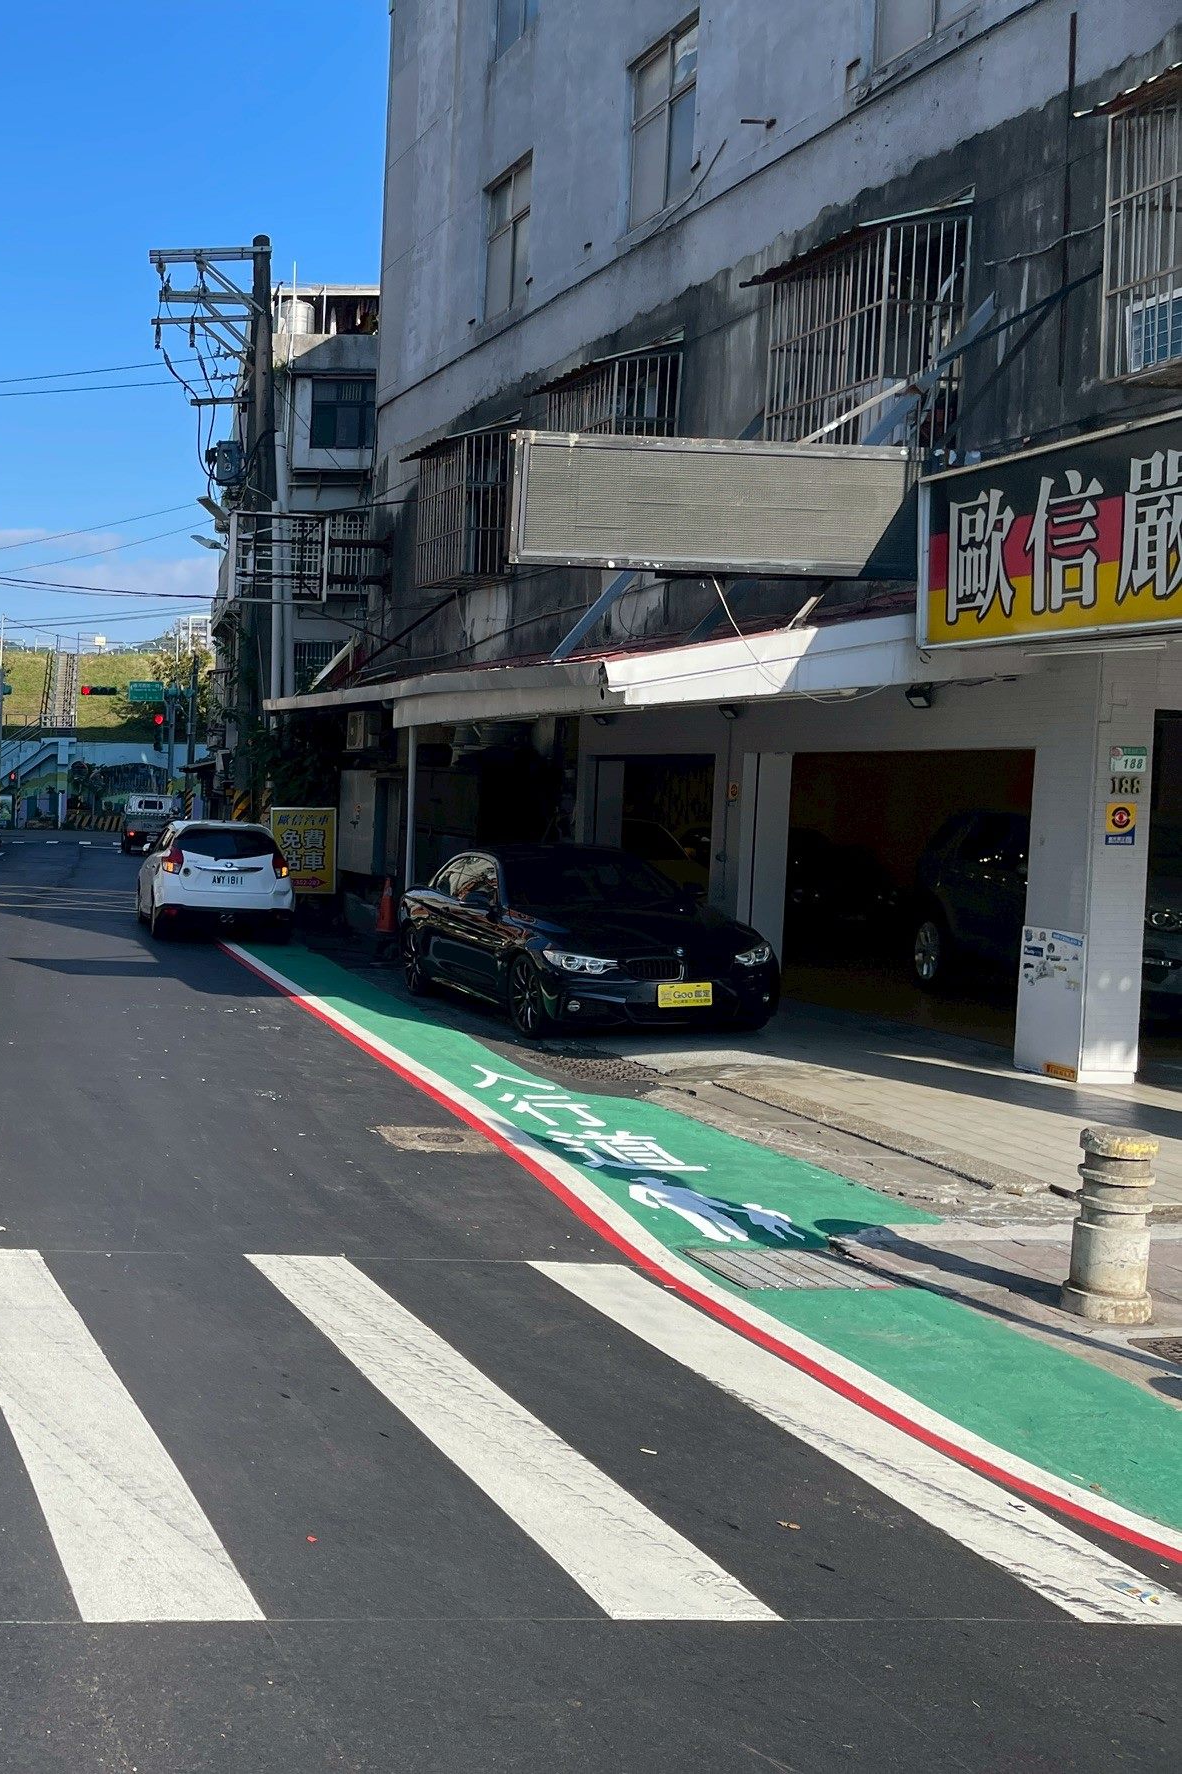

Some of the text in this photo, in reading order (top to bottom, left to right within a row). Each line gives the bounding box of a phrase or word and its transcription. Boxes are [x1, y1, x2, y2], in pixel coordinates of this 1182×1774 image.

[946, 447, 1182, 626] 歐信嚴
[1123, 757, 1144, 770] 188
[1110, 775, 1142, 795] 188
[280, 828, 325, 850] 免費
[284, 850, 325, 871] 估車
[471, 1064, 708, 1172] 人行道
